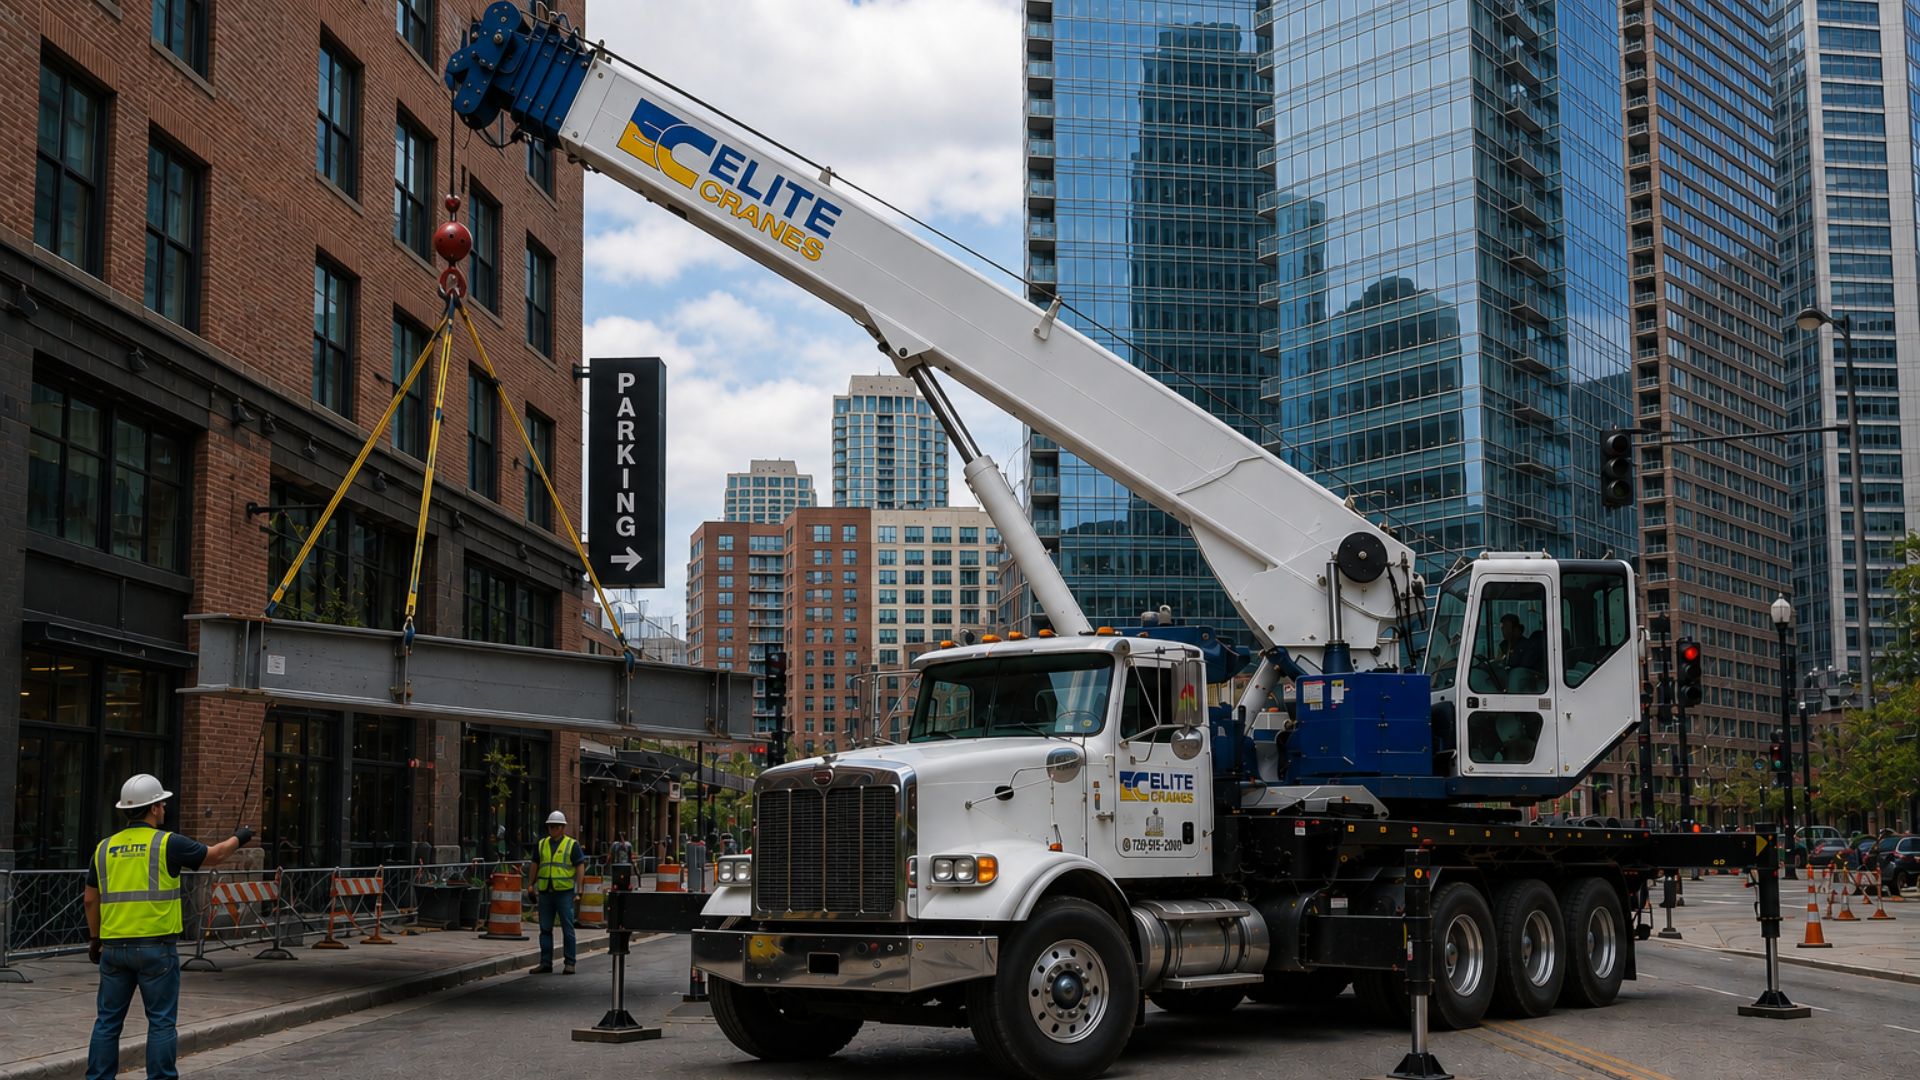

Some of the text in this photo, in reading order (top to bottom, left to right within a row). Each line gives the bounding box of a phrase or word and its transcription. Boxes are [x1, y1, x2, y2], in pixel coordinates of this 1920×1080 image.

[699, 179, 825, 262] CRANES
[708, 144, 843, 239] ELITE
[616, 372, 636, 537] PARKING
[1150, 772, 1194, 790] ELITE
